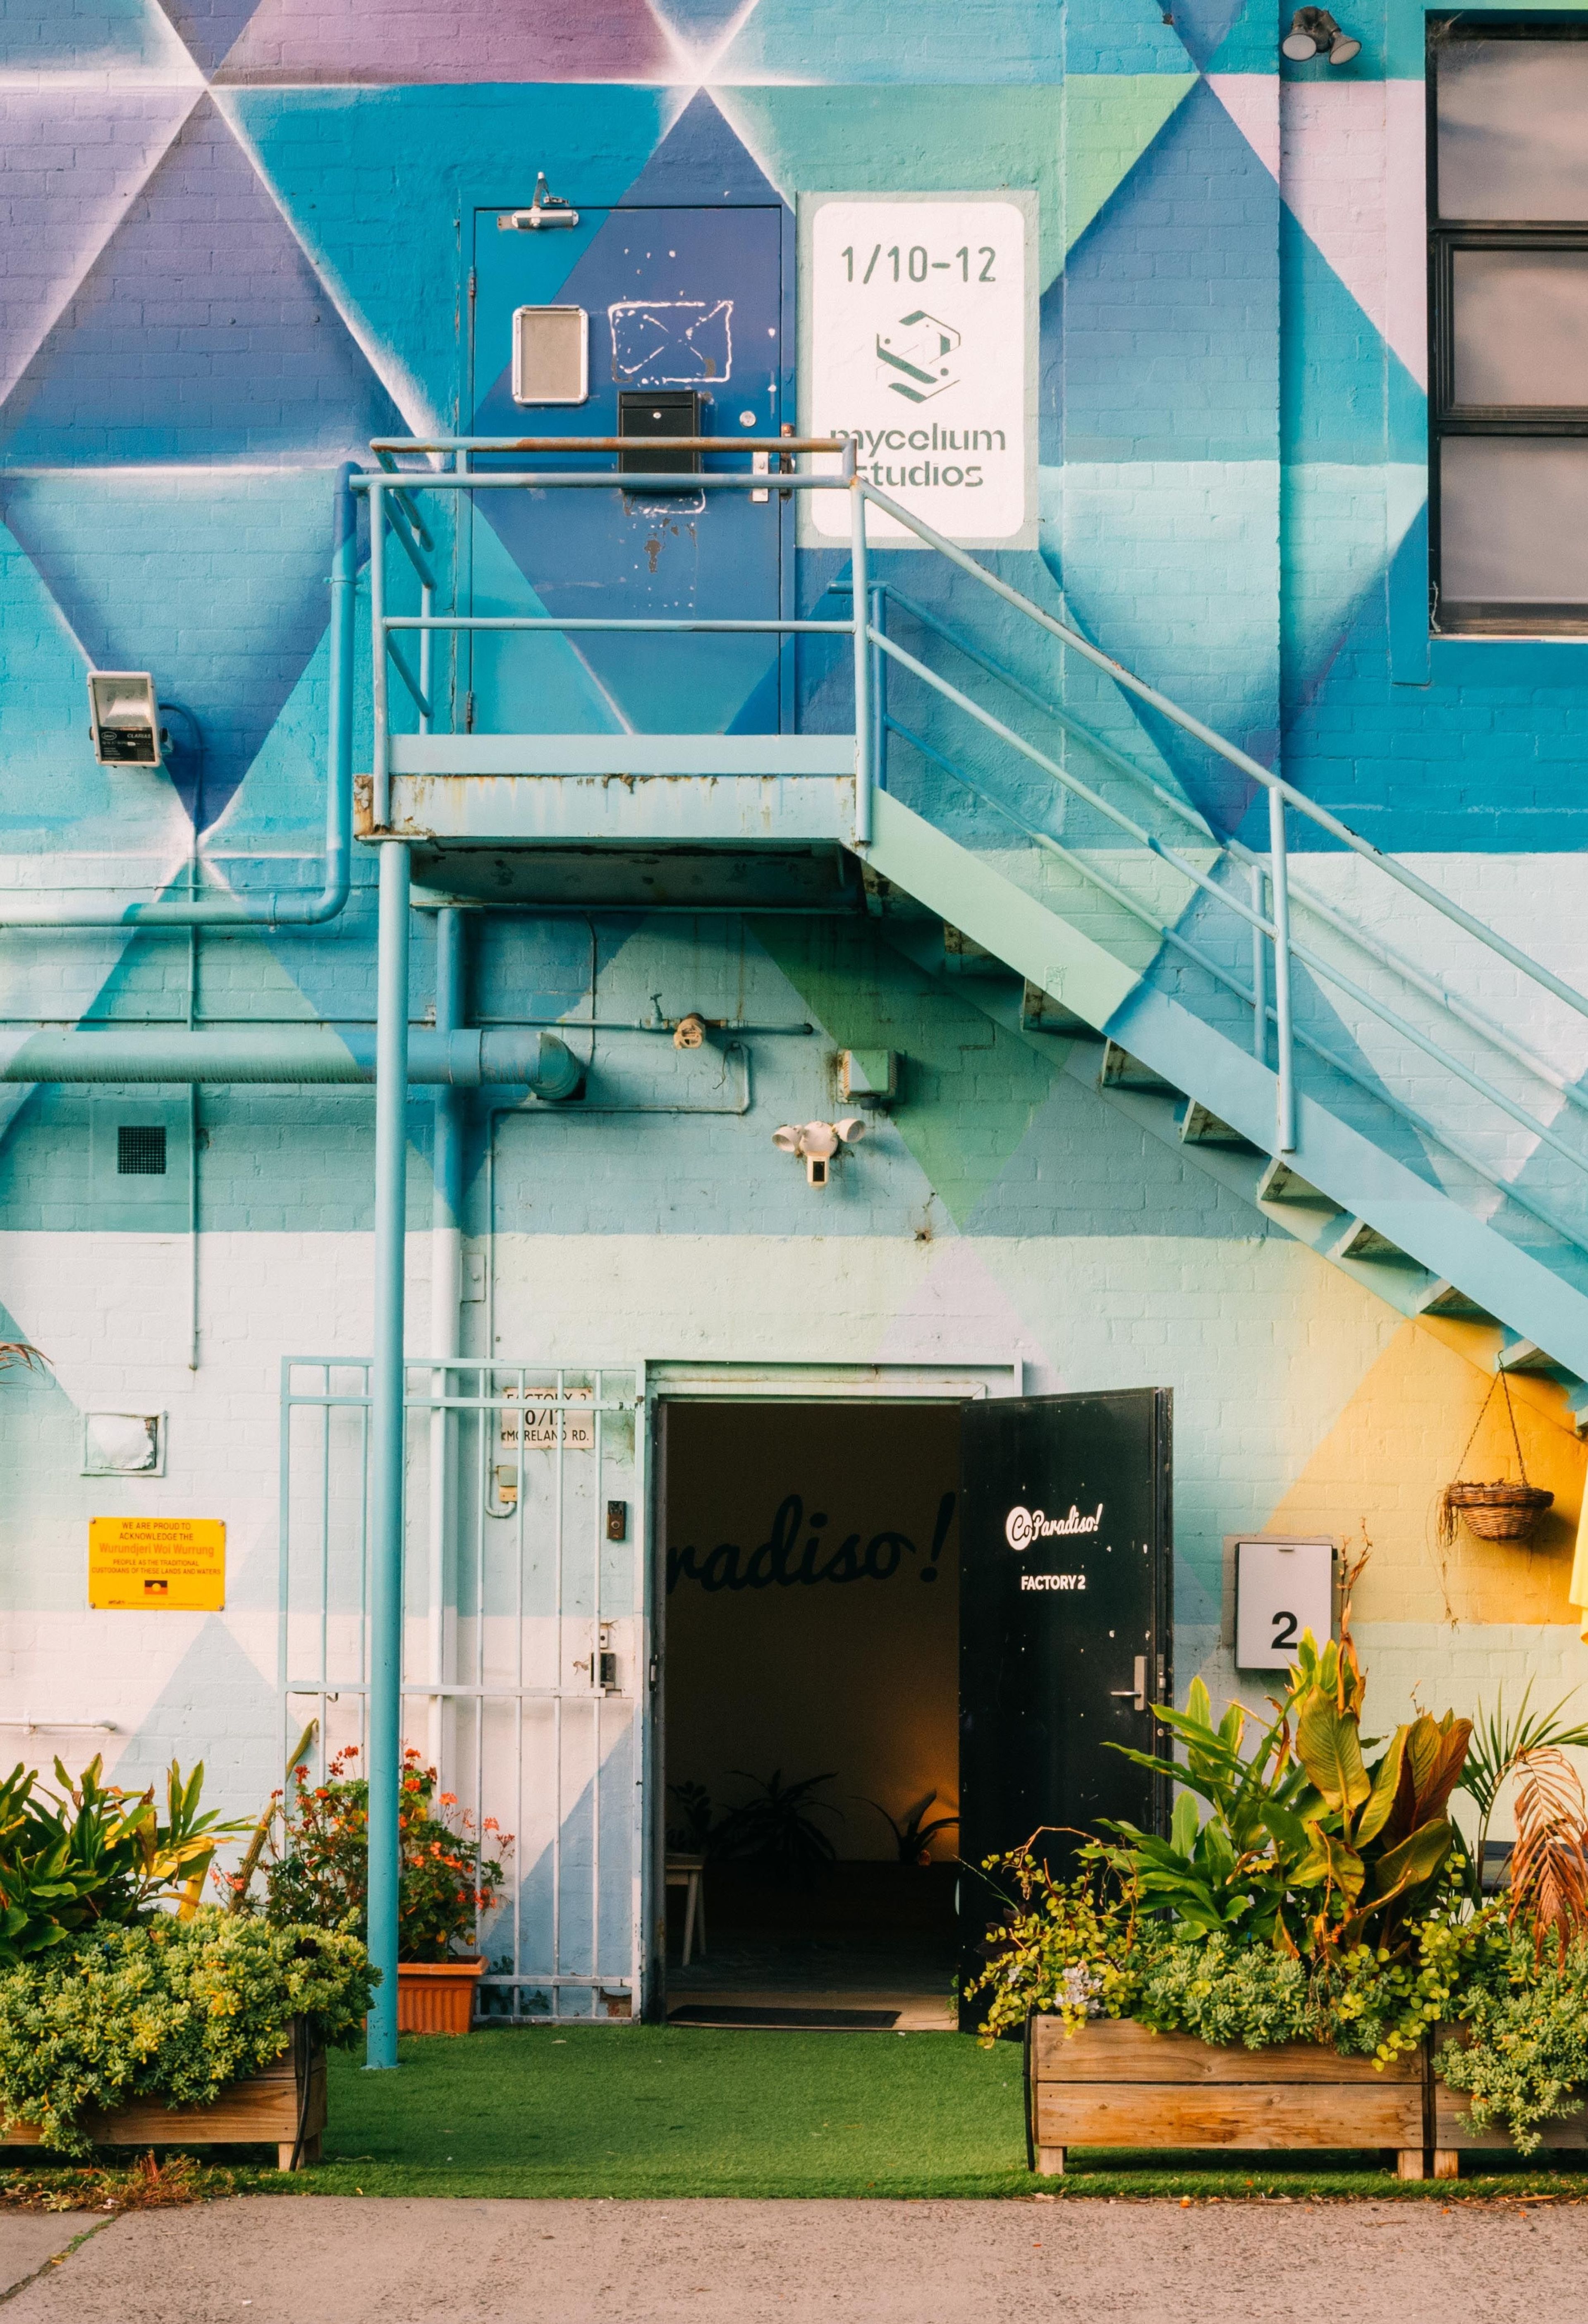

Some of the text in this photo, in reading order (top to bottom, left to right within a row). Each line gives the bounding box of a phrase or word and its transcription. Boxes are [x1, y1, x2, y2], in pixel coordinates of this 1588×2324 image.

[842, 244, 996, 284] 1/10-12
[830, 423, 1005, 458] mycelium
[507, 1430, 589, 1441] MRELAN RD.
[99, 1543, 151, 1556] Wurundjeri
[1021, 1575, 1086, 1590] FACTORY 2
[1271, 1611, 1298, 1649] 2
